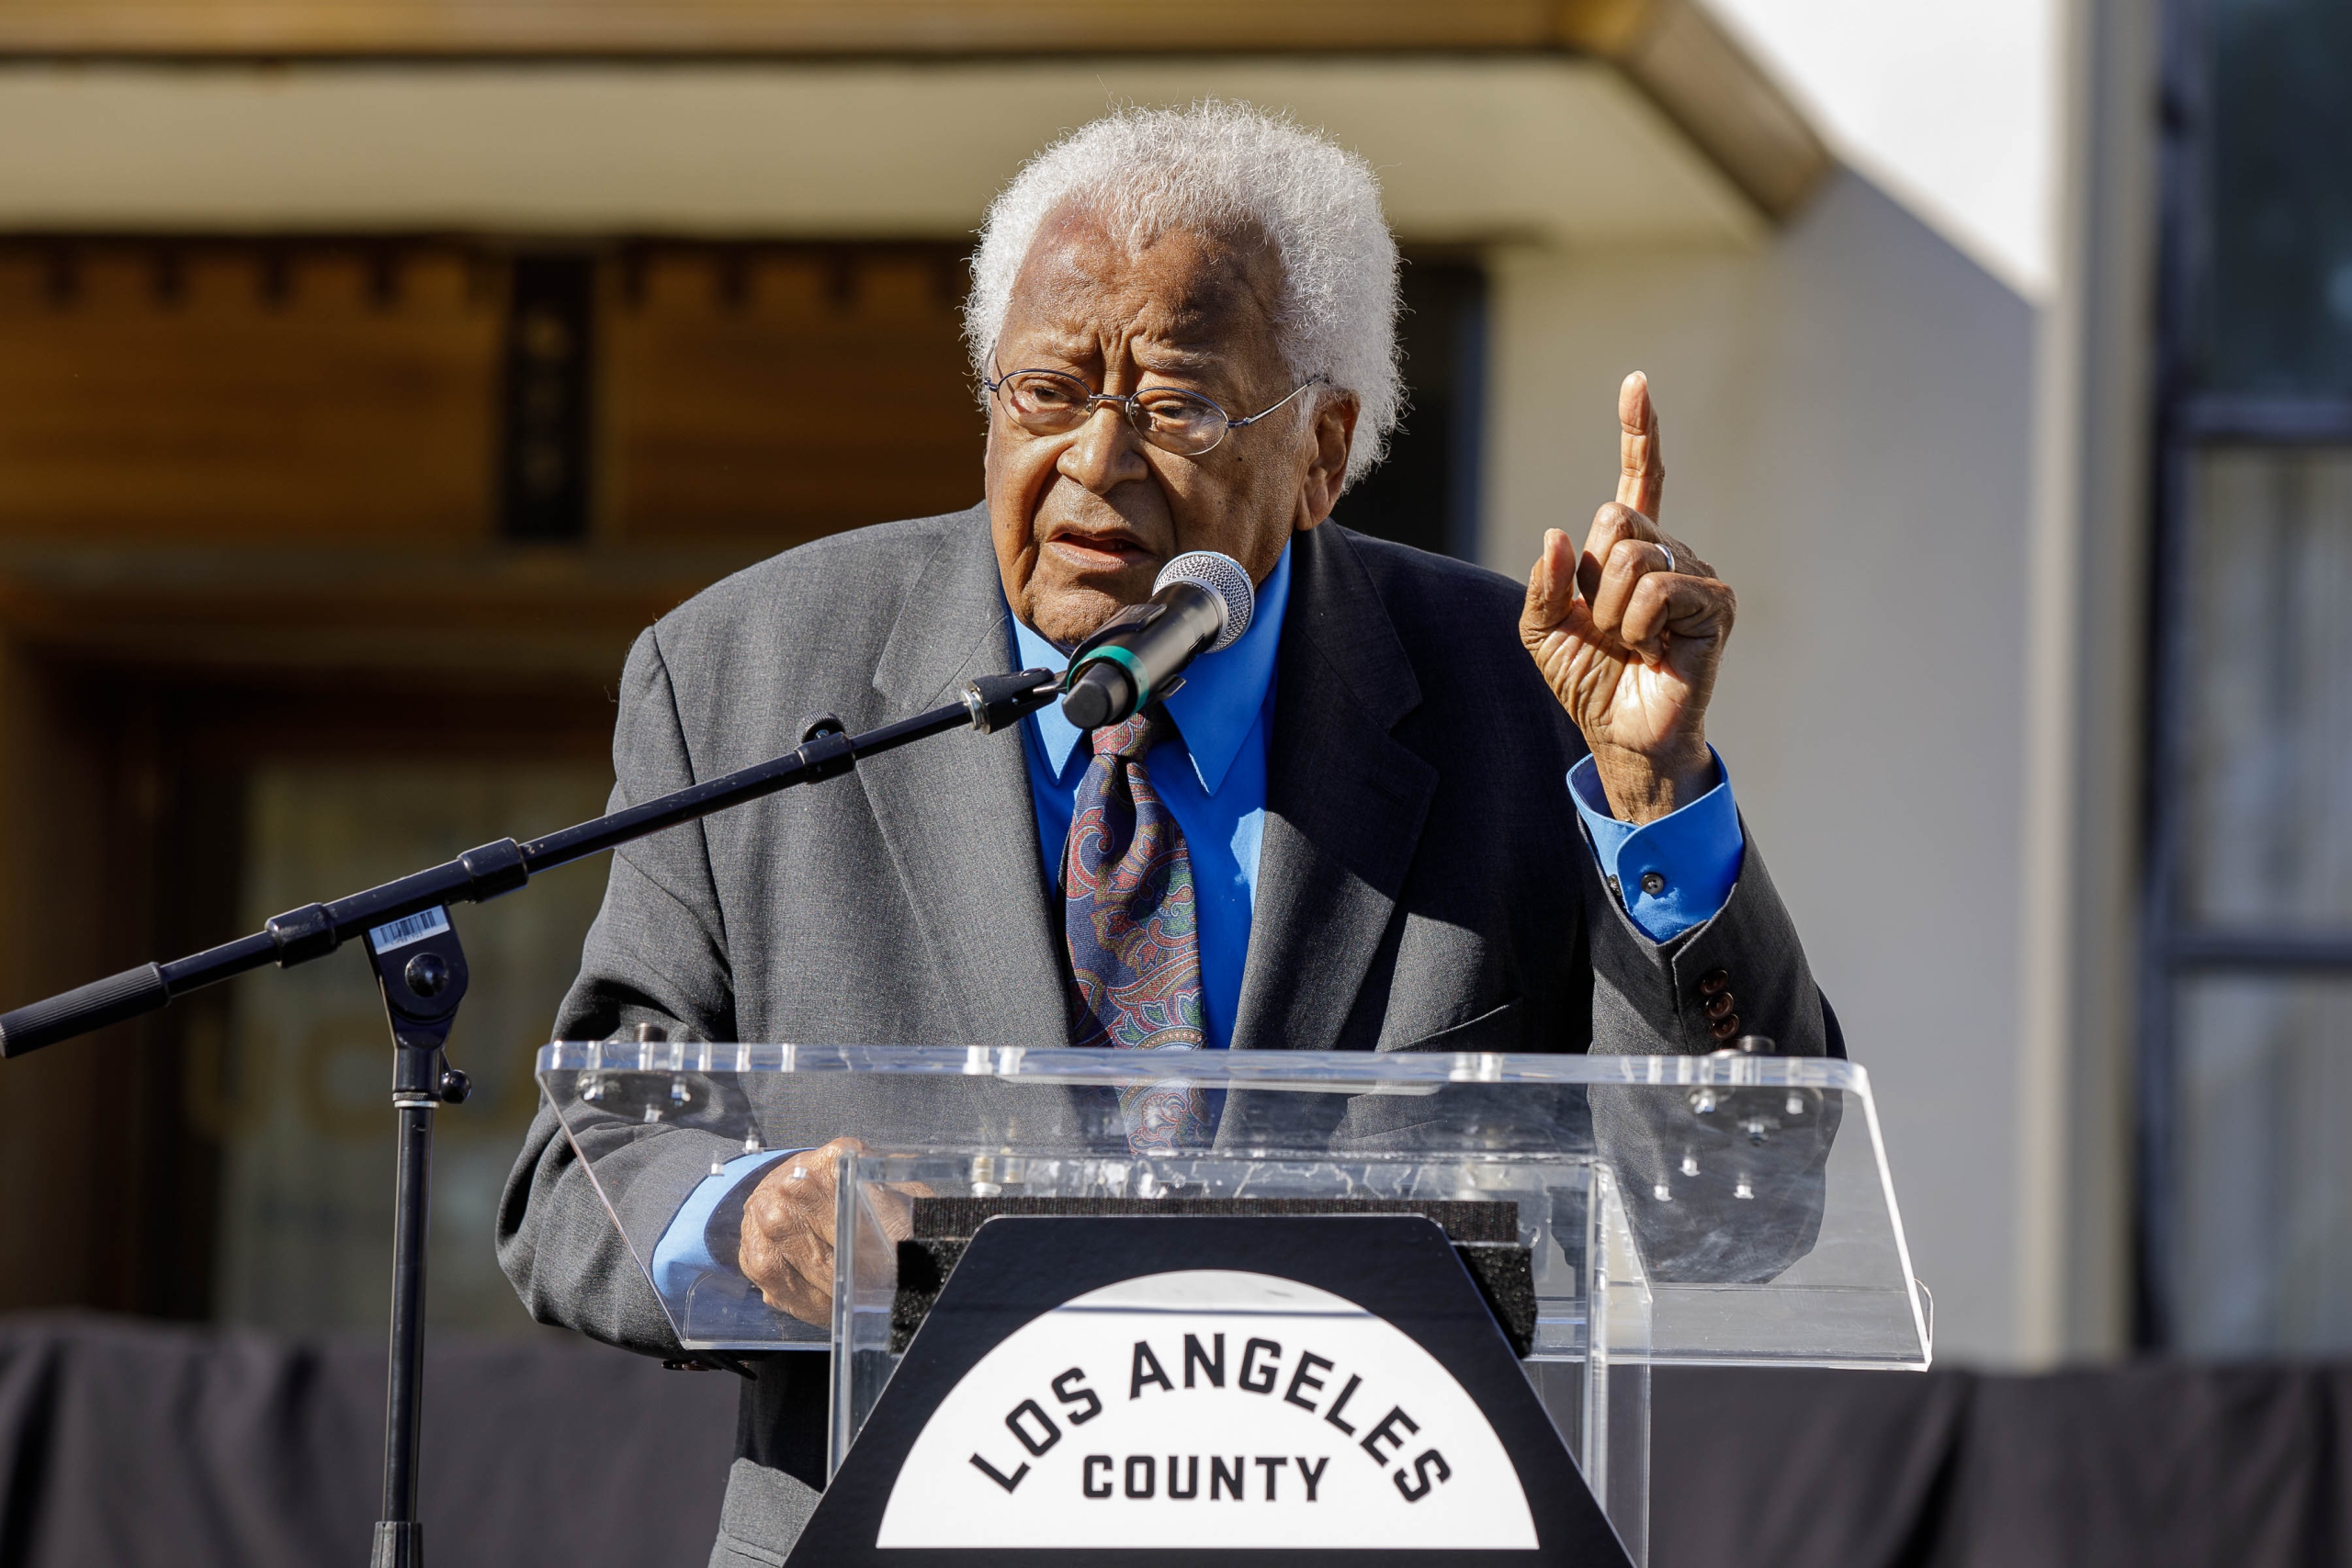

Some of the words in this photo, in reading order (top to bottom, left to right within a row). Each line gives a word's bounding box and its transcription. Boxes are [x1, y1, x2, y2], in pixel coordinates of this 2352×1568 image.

[968, 1367, 1102, 1494] LOS
[1129, 1333, 1452, 1503] ANGELES
[1082, 1455, 1329, 1502] COUNTY
